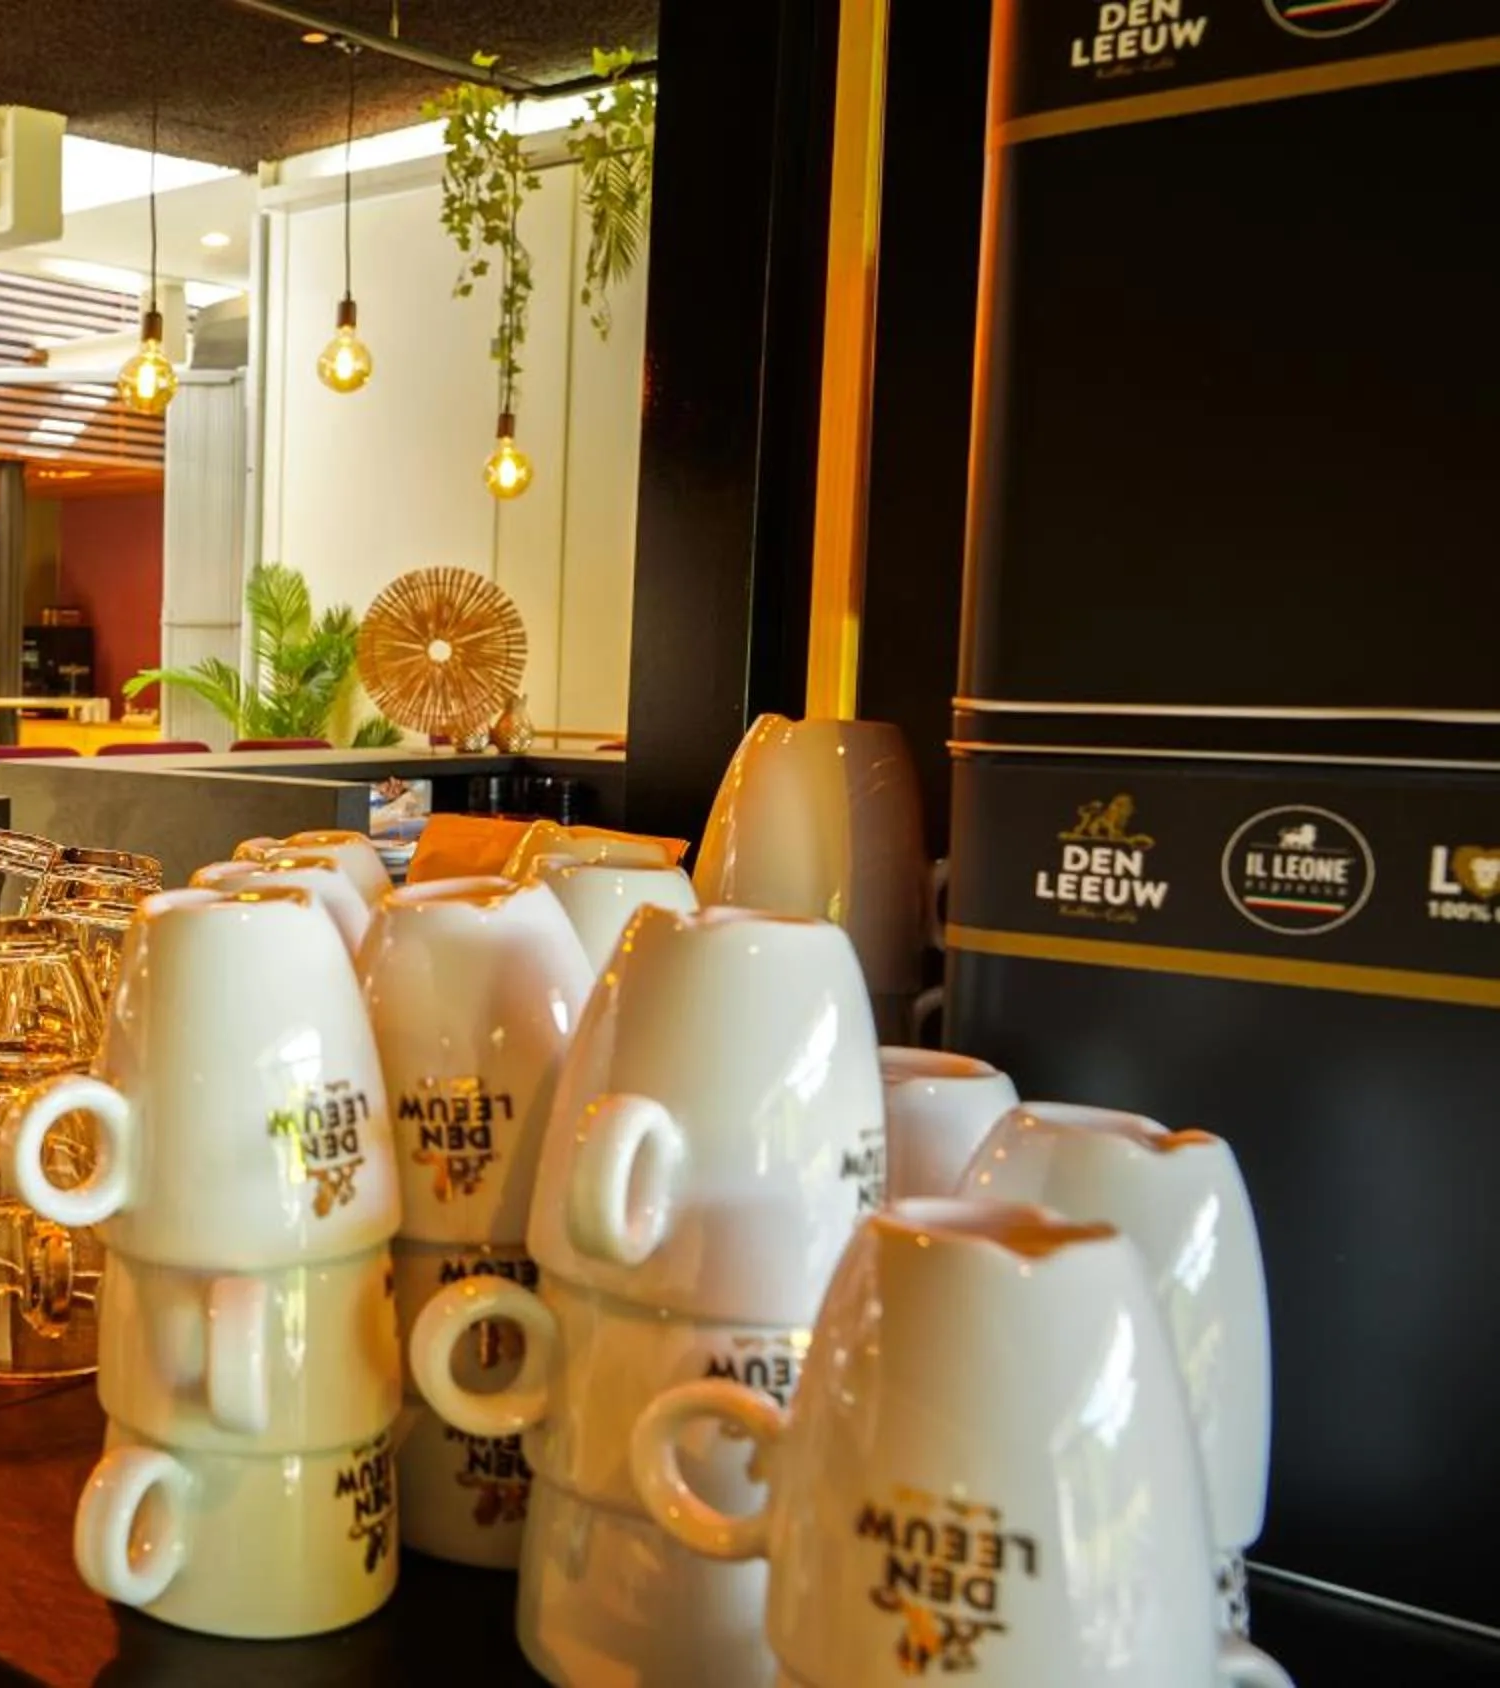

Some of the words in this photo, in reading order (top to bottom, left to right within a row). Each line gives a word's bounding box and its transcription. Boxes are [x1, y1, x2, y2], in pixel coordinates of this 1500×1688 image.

[1099, 0, 1181, 31] DEN
[1071, 16, 1207, 67] LEEUW
[1063, 844, 1143, 877] DEN
[1246, 852, 1268, 878] IL
[1272, 854, 1349, 884] LEONE
[1035, 871, 1169, 909] LEEUW
[268, 1093, 369, 1137] LEEUW
[398, 1093, 514, 1120] LEEUW
[300, 1128, 359, 1160] DEN
[420, 1124, 492, 1150] DEN
[857, 1502, 1037, 1578] LEEUW
[886, 1553, 997, 1612] DEN
